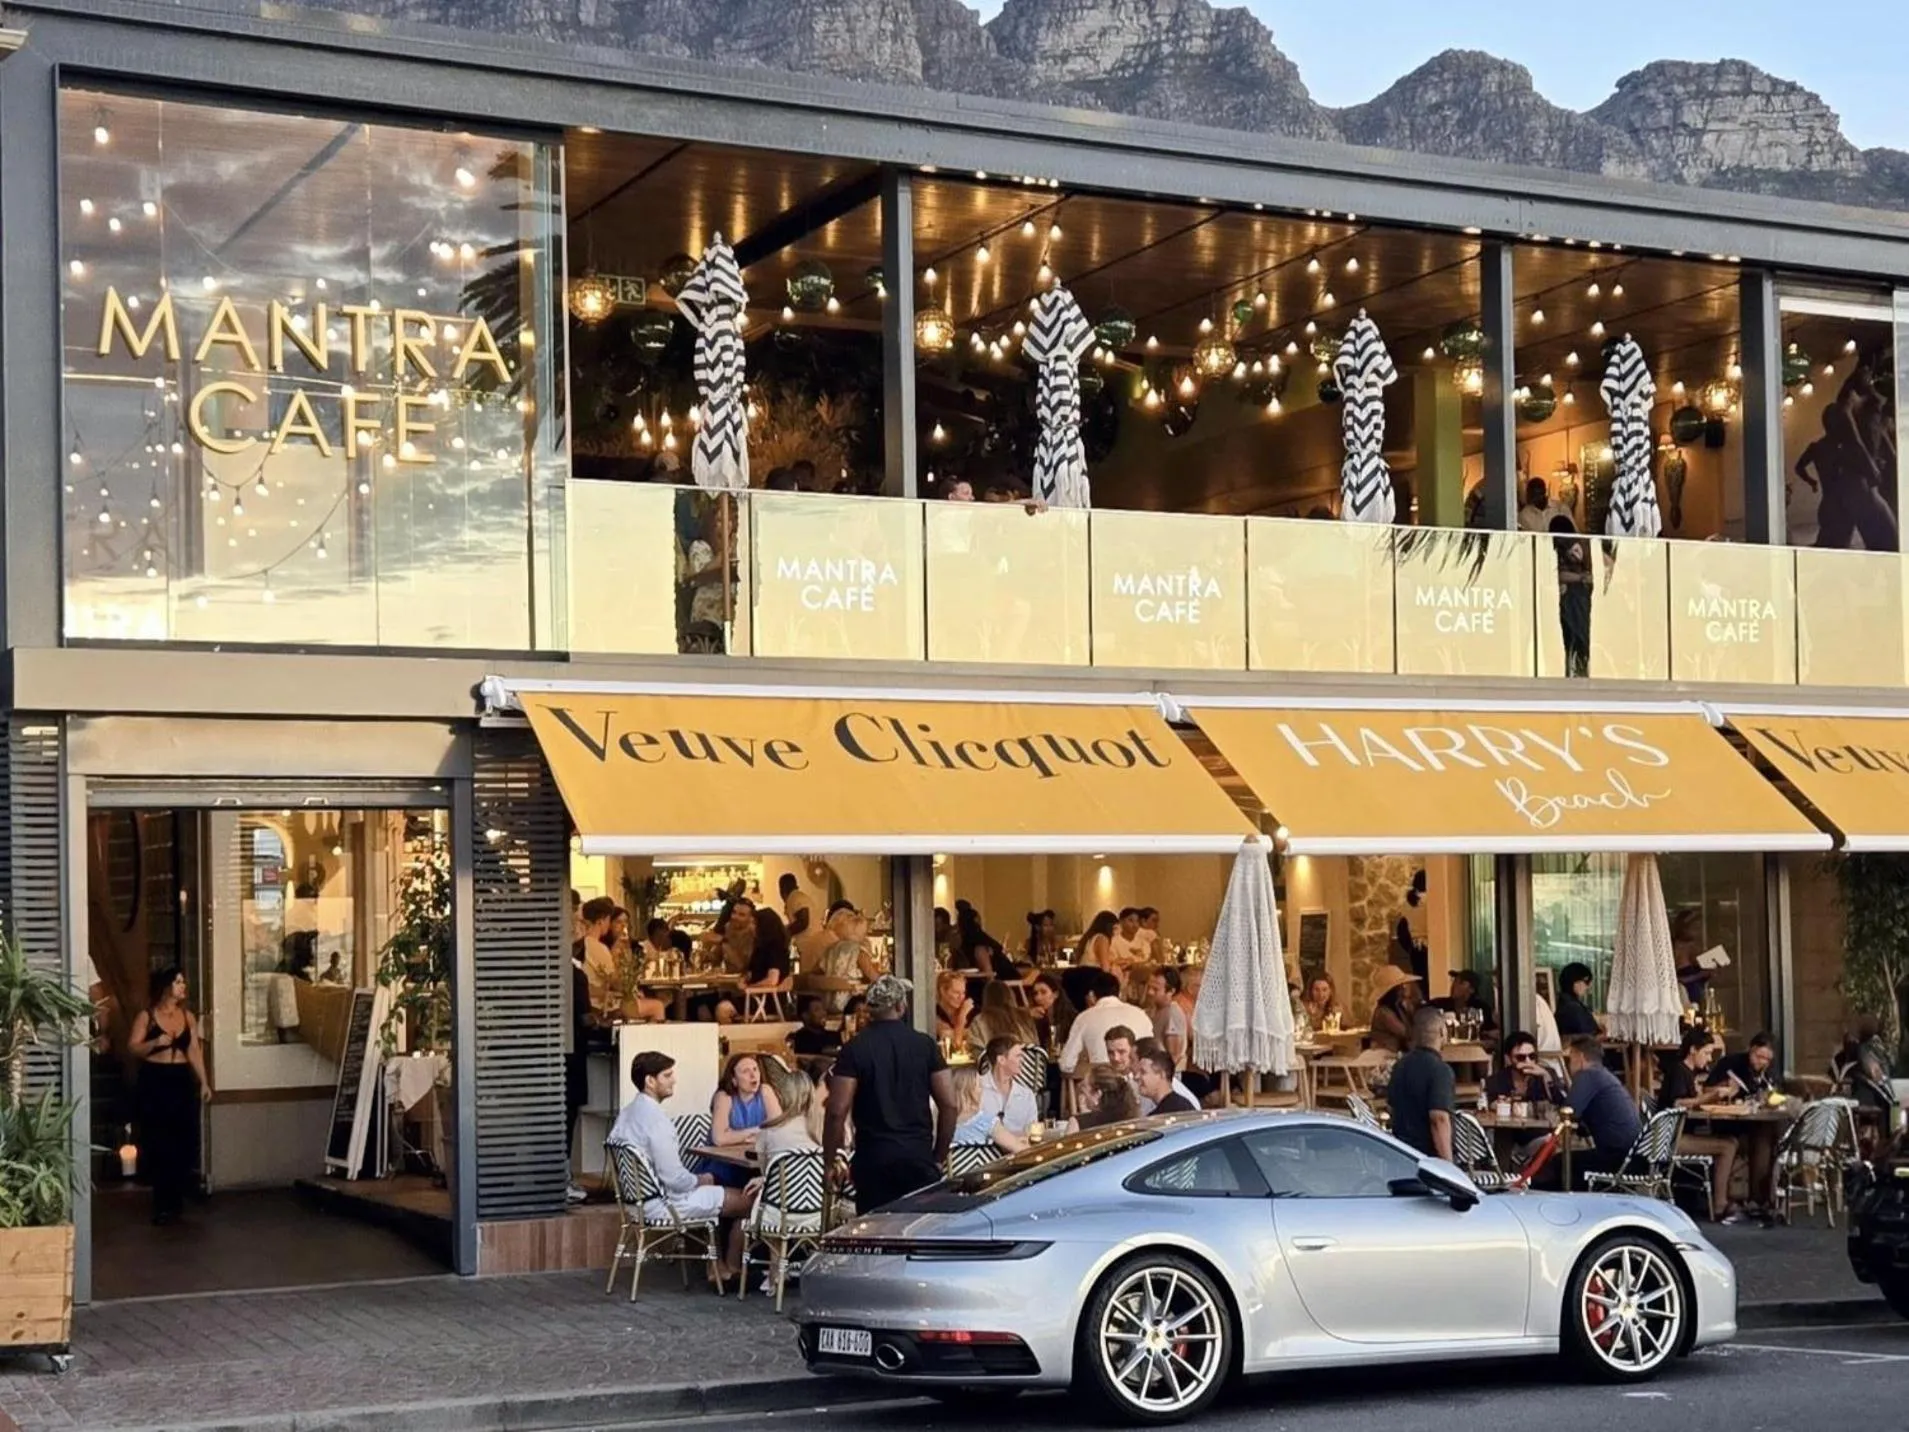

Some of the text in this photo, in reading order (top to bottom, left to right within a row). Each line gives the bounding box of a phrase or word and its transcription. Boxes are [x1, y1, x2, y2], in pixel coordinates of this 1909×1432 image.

[99, 286, 512, 383] MANTRA
[188, 379, 437, 462] CAFÉ
[776, 556, 898, 586] MANTRA
[1112, 571, 1223, 600] MANTRA
[800, 584, 875, 612] CAFÉ
[1134, 597, 1201, 624] CAFÉ
[1415, 585, 1513, 610] MANTRA
[1687, 596, 1777, 620] MANTRA
[1434, 607, 1494, 634] CAFÉ
[1705, 619, 1760, 643] CAFÉ
[535, 704, 1171, 779] Veuve Clicquot
[1276, 723, 1670, 774] HARRY'S
[1748, 726, 1909, 774] Veuv
[1495, 768, 1672, 829] Beach
